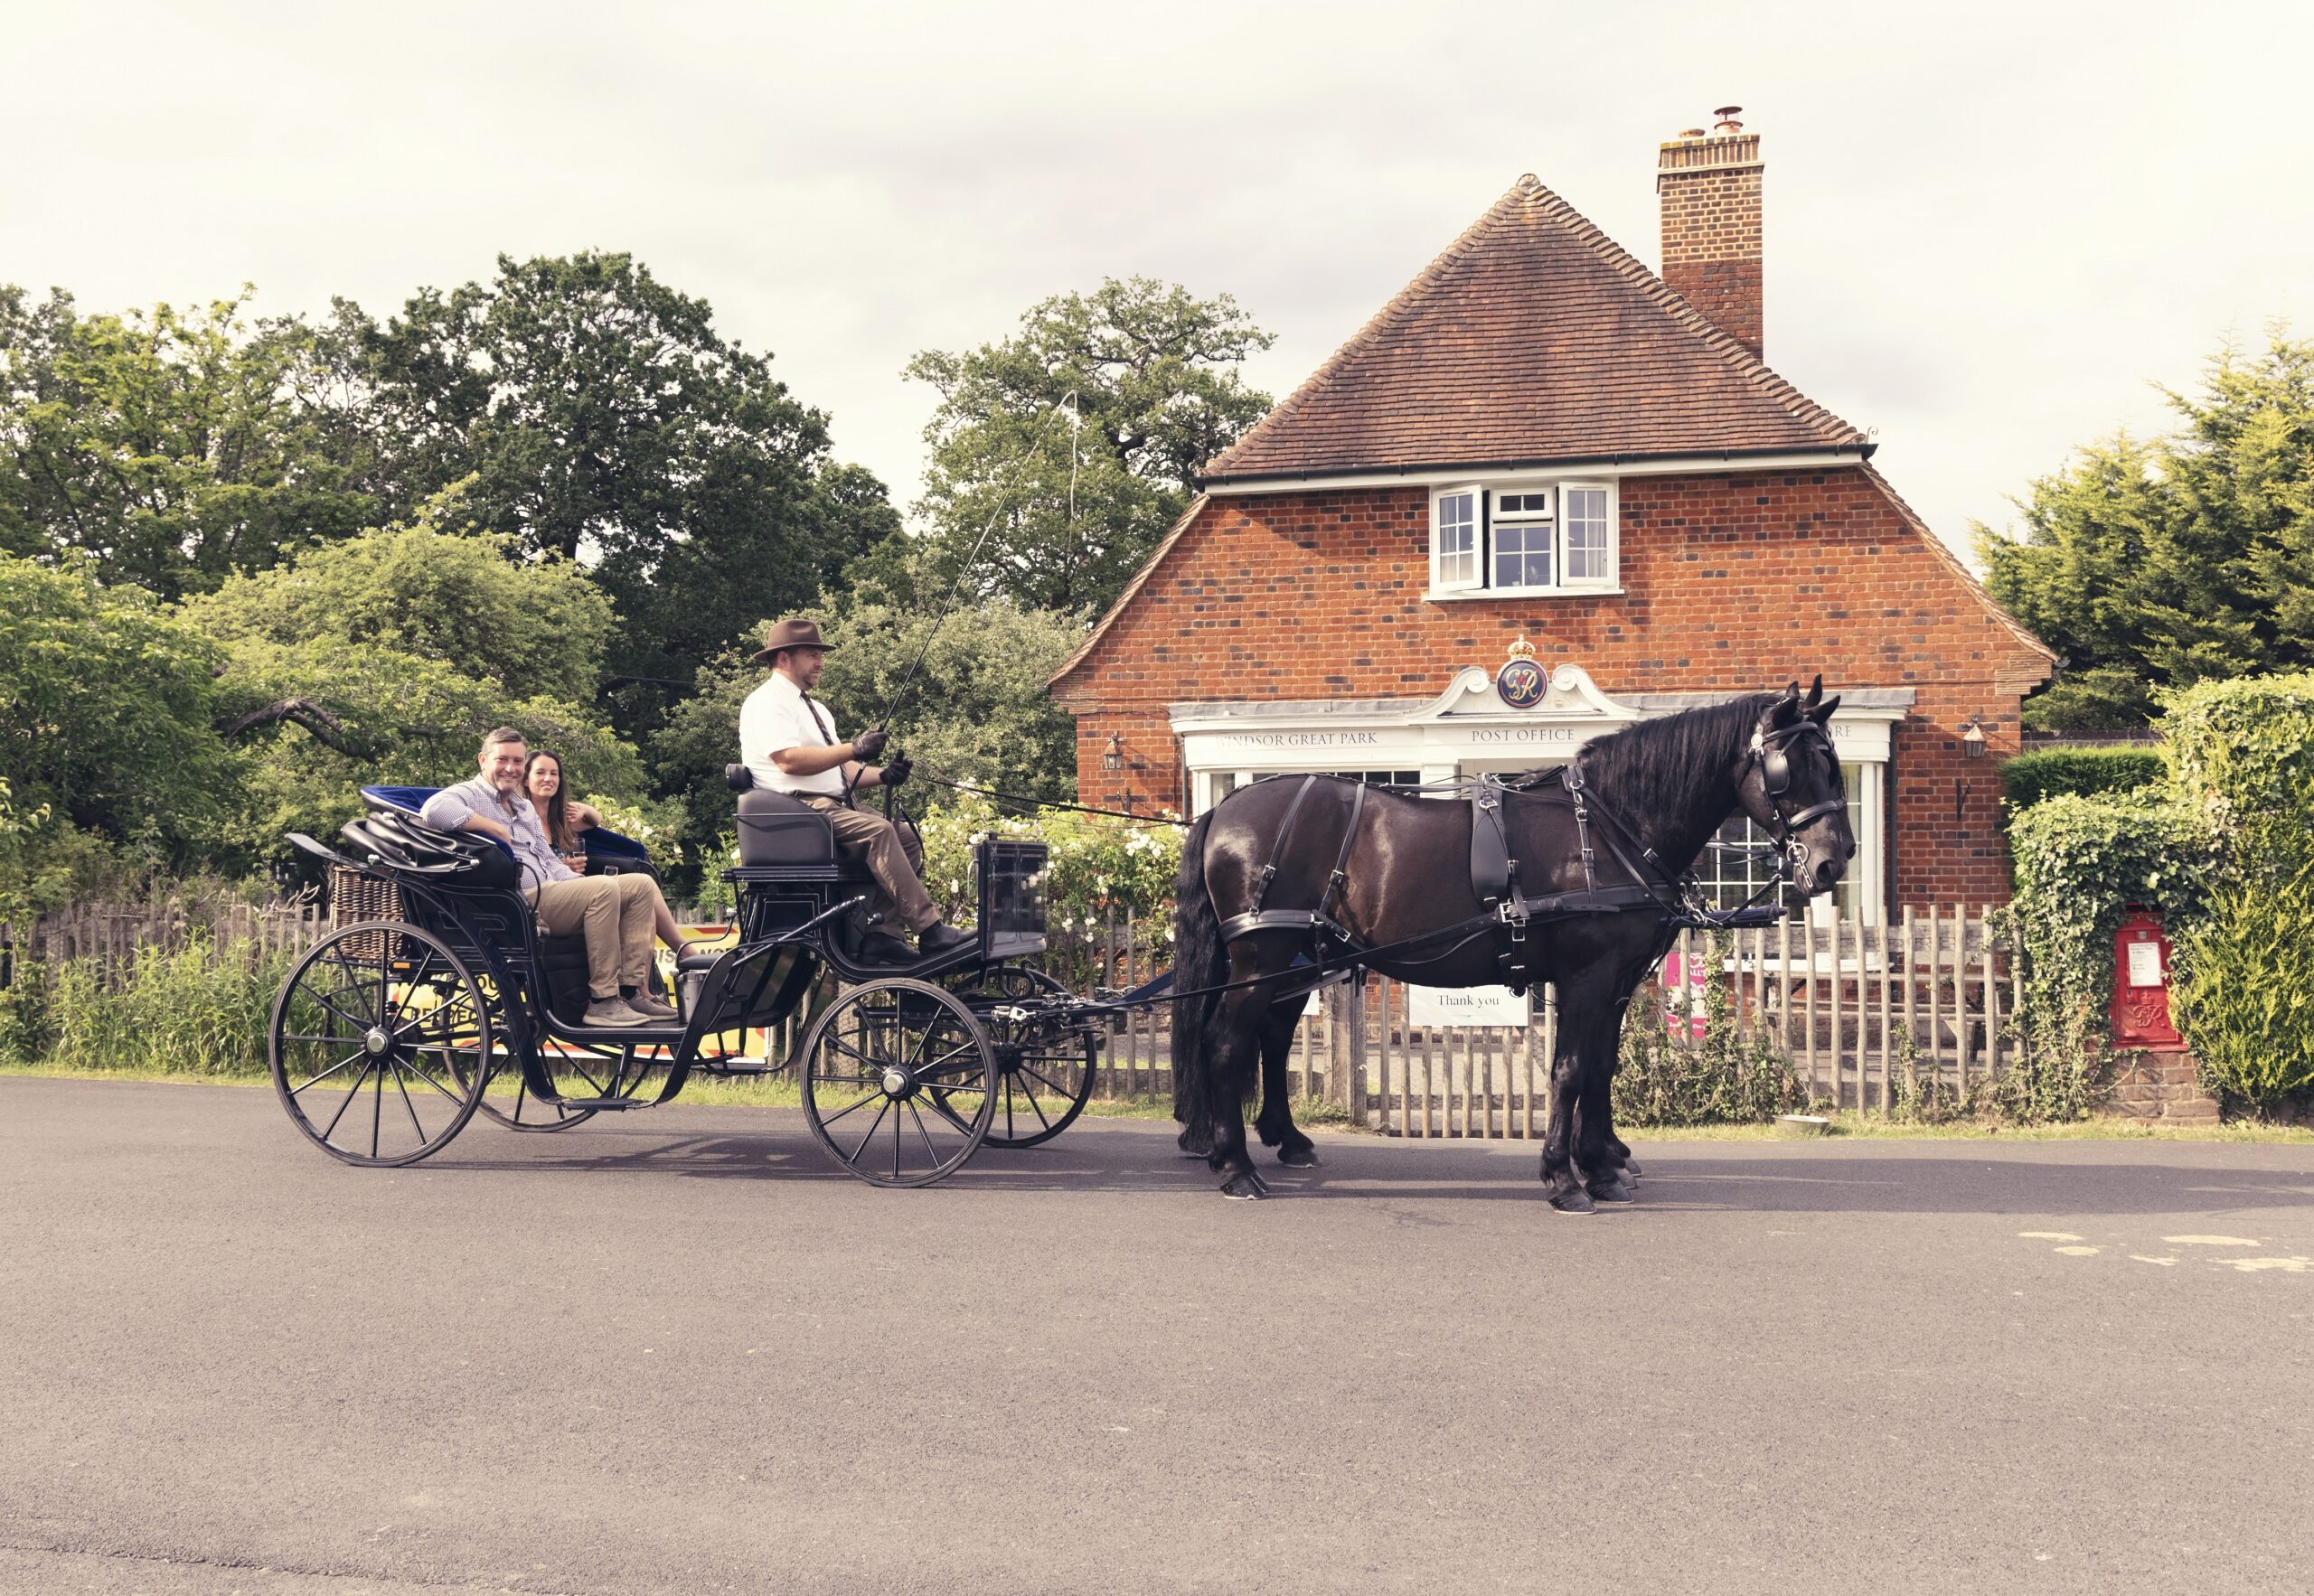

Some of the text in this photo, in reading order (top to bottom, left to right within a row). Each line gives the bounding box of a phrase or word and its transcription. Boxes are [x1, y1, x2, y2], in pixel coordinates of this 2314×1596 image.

[1288, 733, 1335, 746] GREAT
[1340, 732, 1378, 745] PARK
[1472, 728, 1575, 742] POST OFFICE
[1437, 994, 1500, 1009] Thank you
